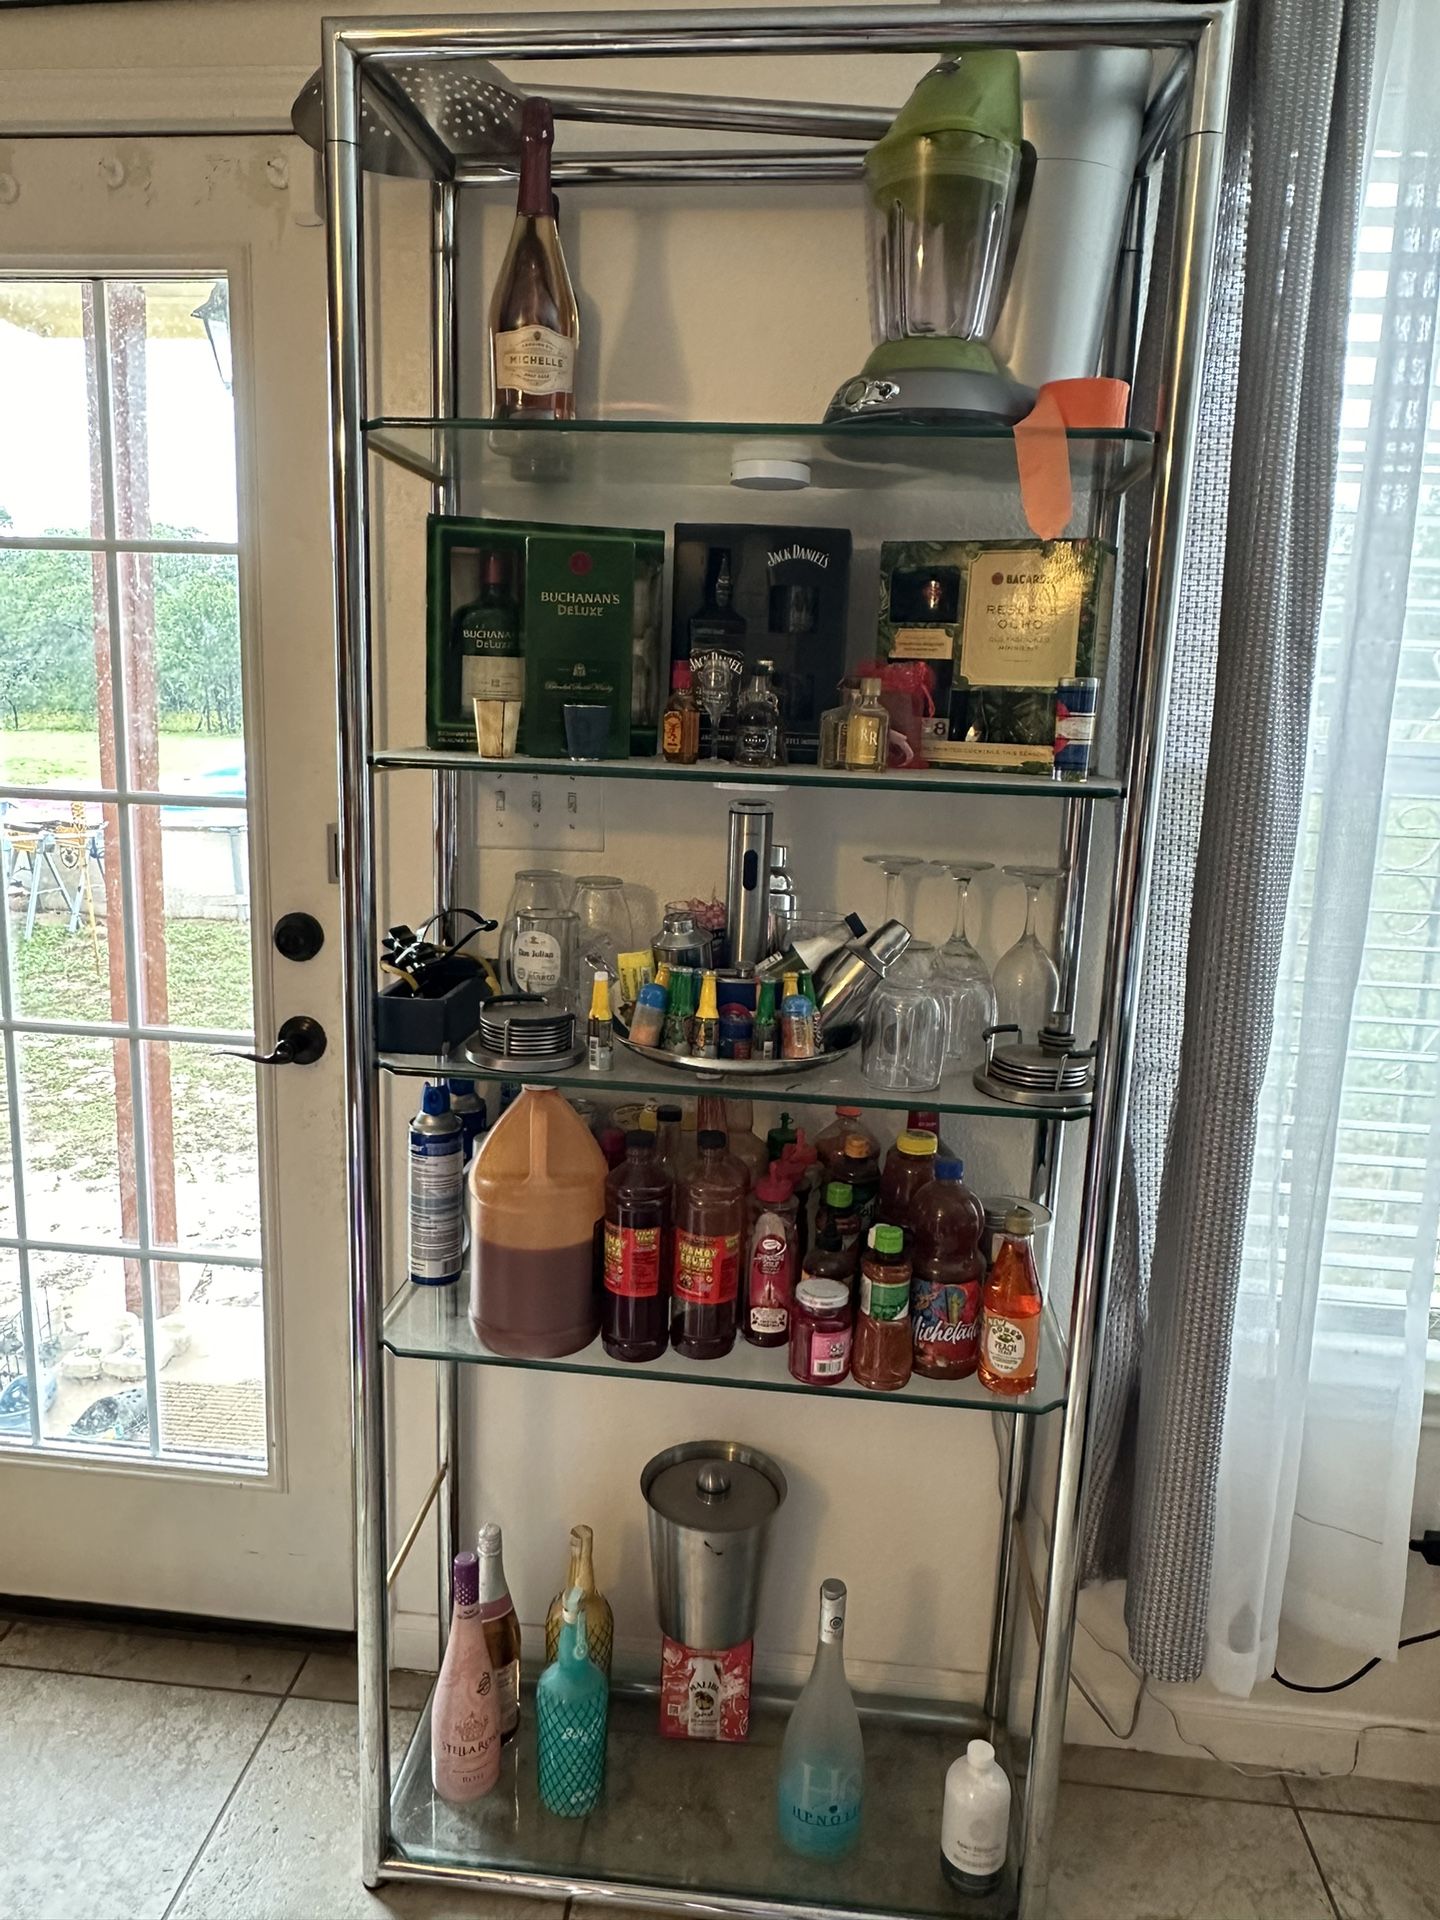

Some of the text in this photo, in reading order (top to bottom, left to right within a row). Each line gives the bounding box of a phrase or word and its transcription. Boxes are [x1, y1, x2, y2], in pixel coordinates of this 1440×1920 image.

[509, 355, 564, 368] MICHELLE
[767, 543, 831, 569] JACK DANIEL'S
[1006, 574, 1048, 585] BACARD
[541, 591, 620, 605] BUCHANAN'S
[557, 604, 604, 617] DELUXE
[463, 629, 512, 640] BUCHANA
[933, 721, 946, 736] 8
[678, 1242, 719, 1258] CHAMOY
[680, 1252, 714, 1268] FRUTA
[913, 1315, 977, 1345] Michelad
[441, 1740, 476, 1757] STELLA
